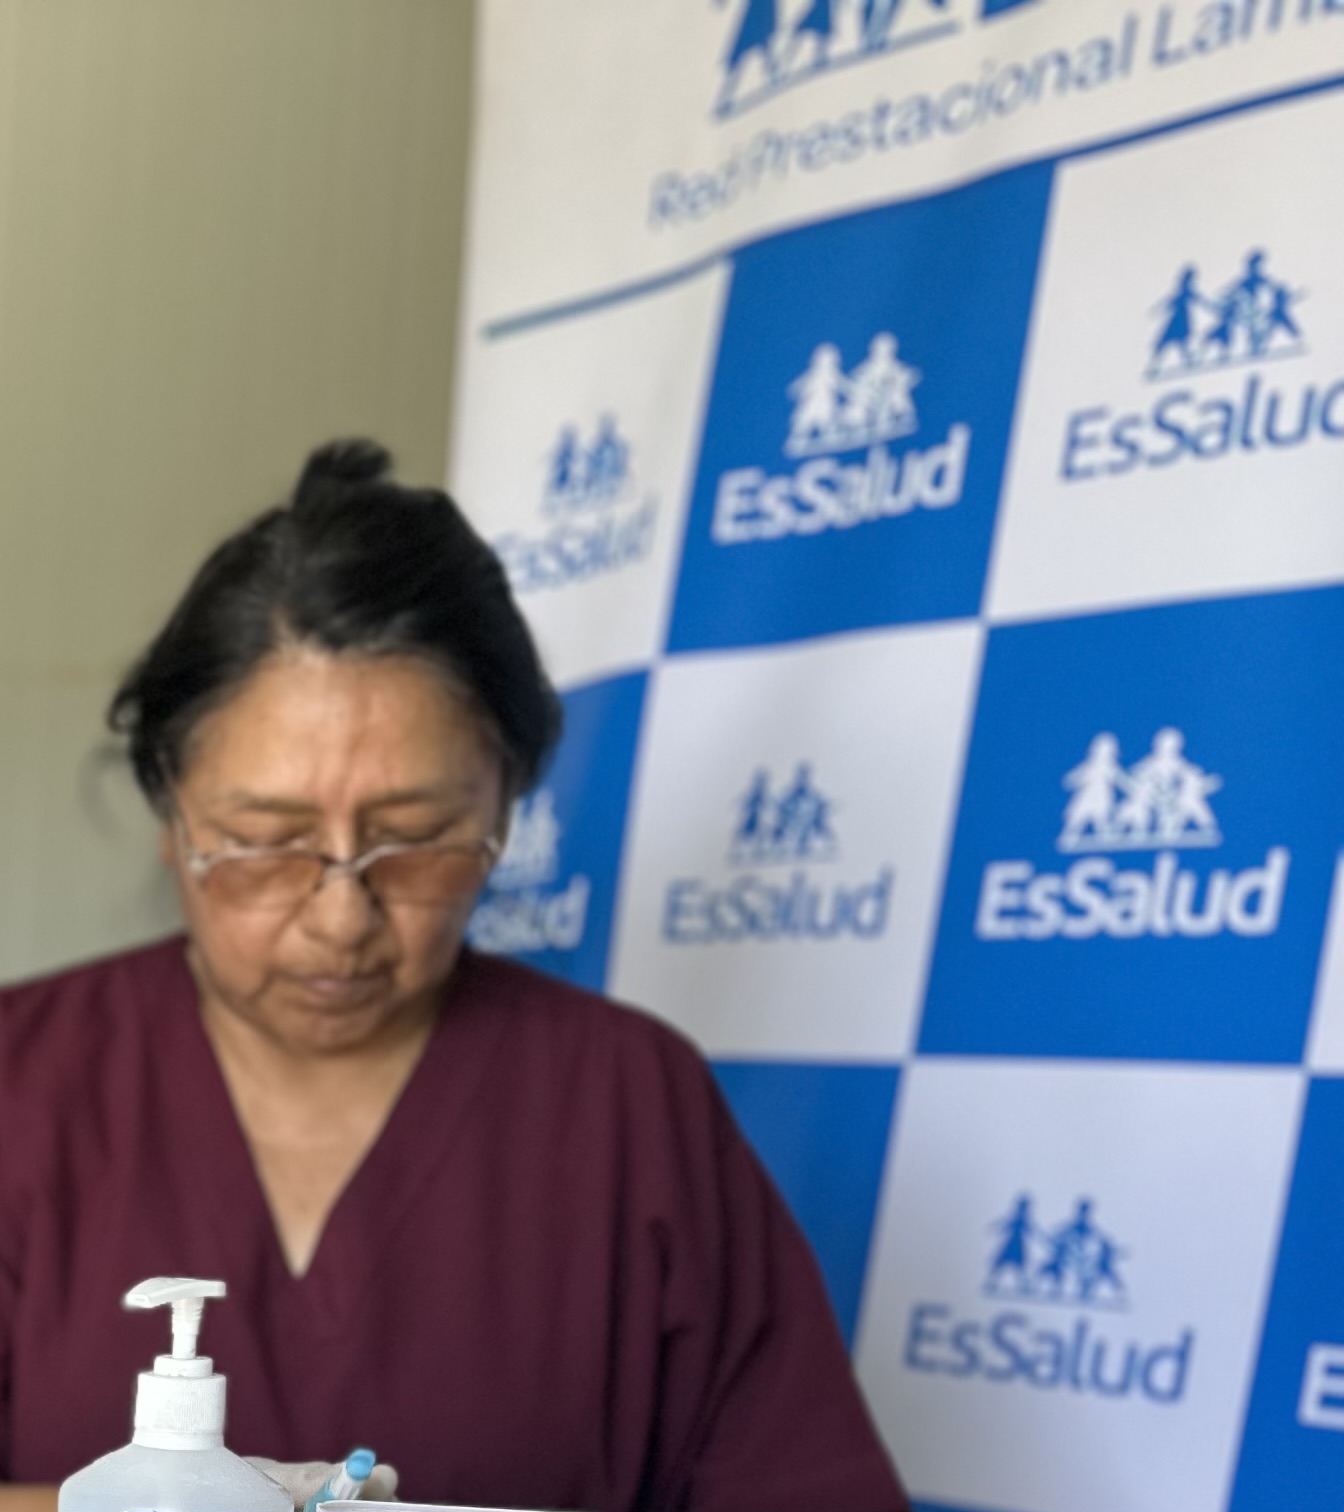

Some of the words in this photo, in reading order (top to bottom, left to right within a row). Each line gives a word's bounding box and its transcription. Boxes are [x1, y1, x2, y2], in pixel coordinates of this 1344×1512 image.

[749, 11, 1139, 190] Prestacional
[713, 424, 970, 545] EsSalud
[661, 865, 894, 946] EsSalud
[974, 846, 1290, 941] EsSalud
[902, 1303, 1196, 1403] EsSalud
